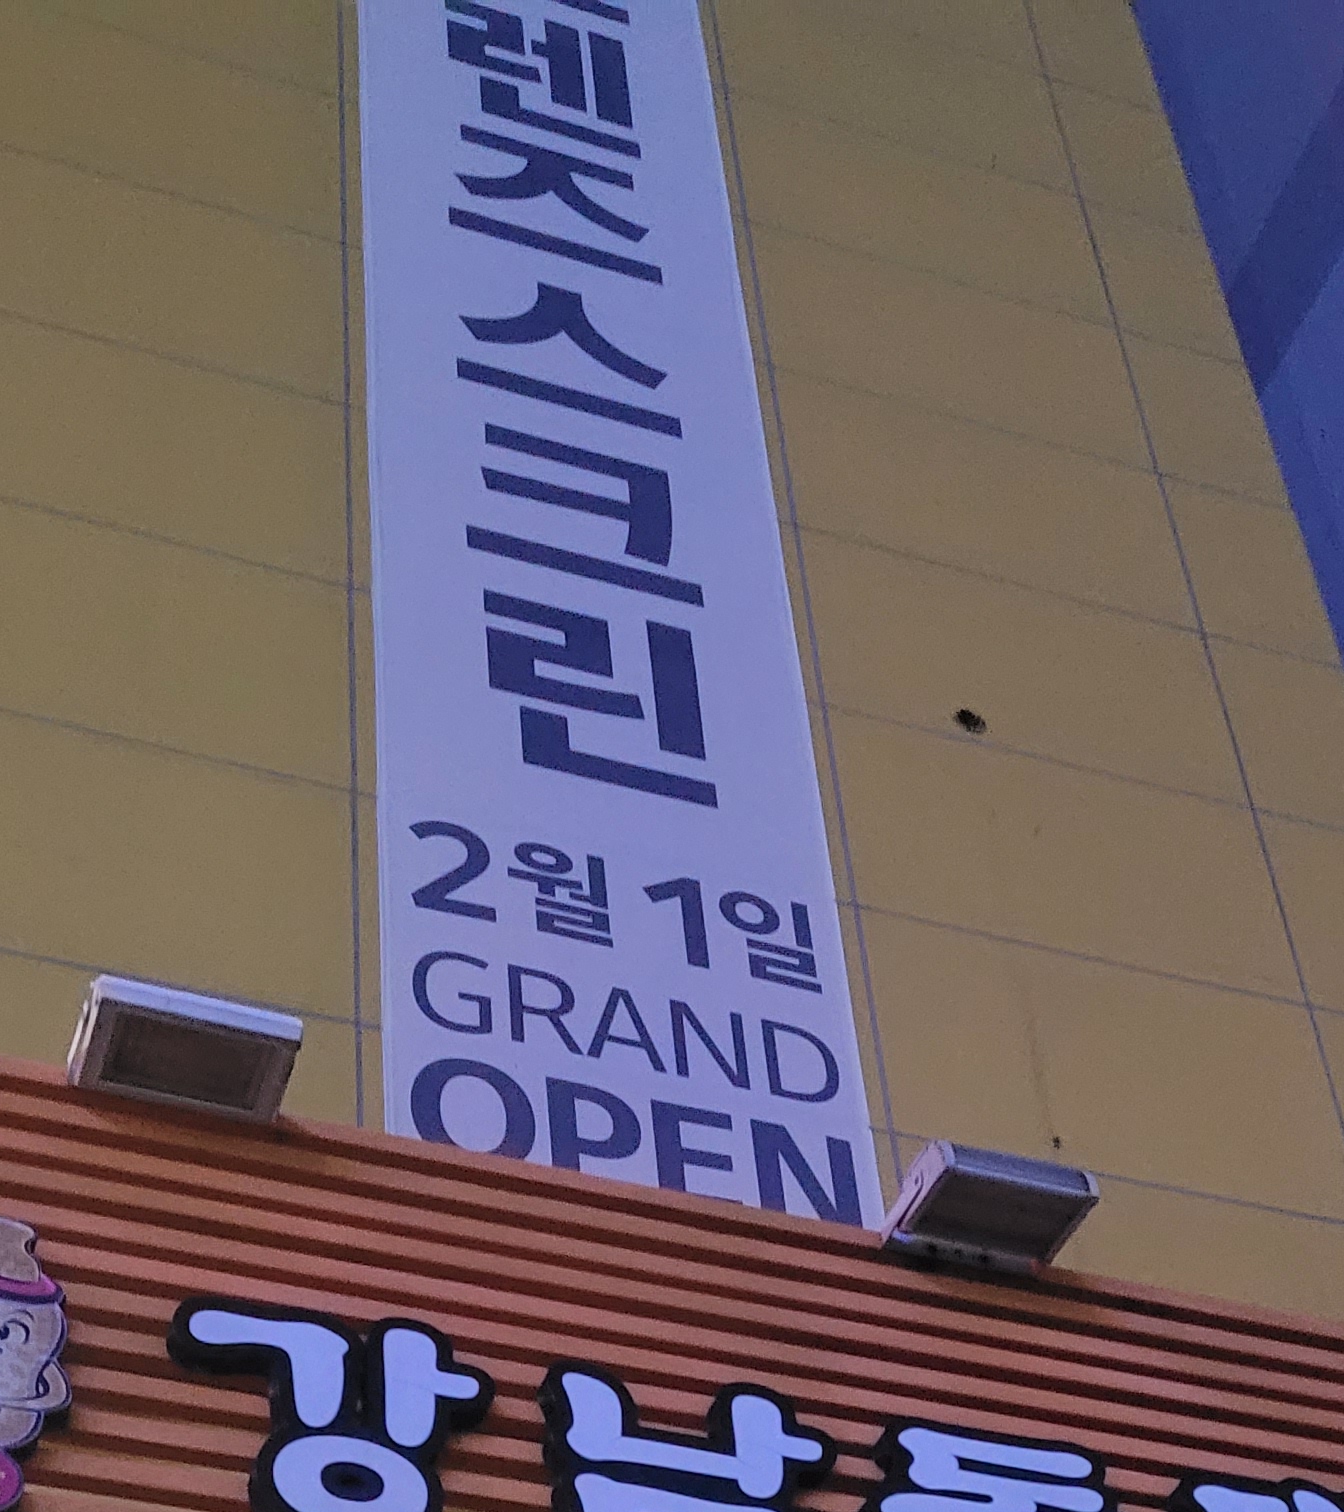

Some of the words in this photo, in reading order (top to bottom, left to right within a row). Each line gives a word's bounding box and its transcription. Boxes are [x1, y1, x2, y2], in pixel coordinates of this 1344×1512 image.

[445, 0, 719, 809] 렌즈스크린
[408, 820, 614, 948] 2월
[642, 877, 823, 994] 1일
[410, 950, 841, 1103] GRAND
[409, 1057, 863, 1229] OPEN
